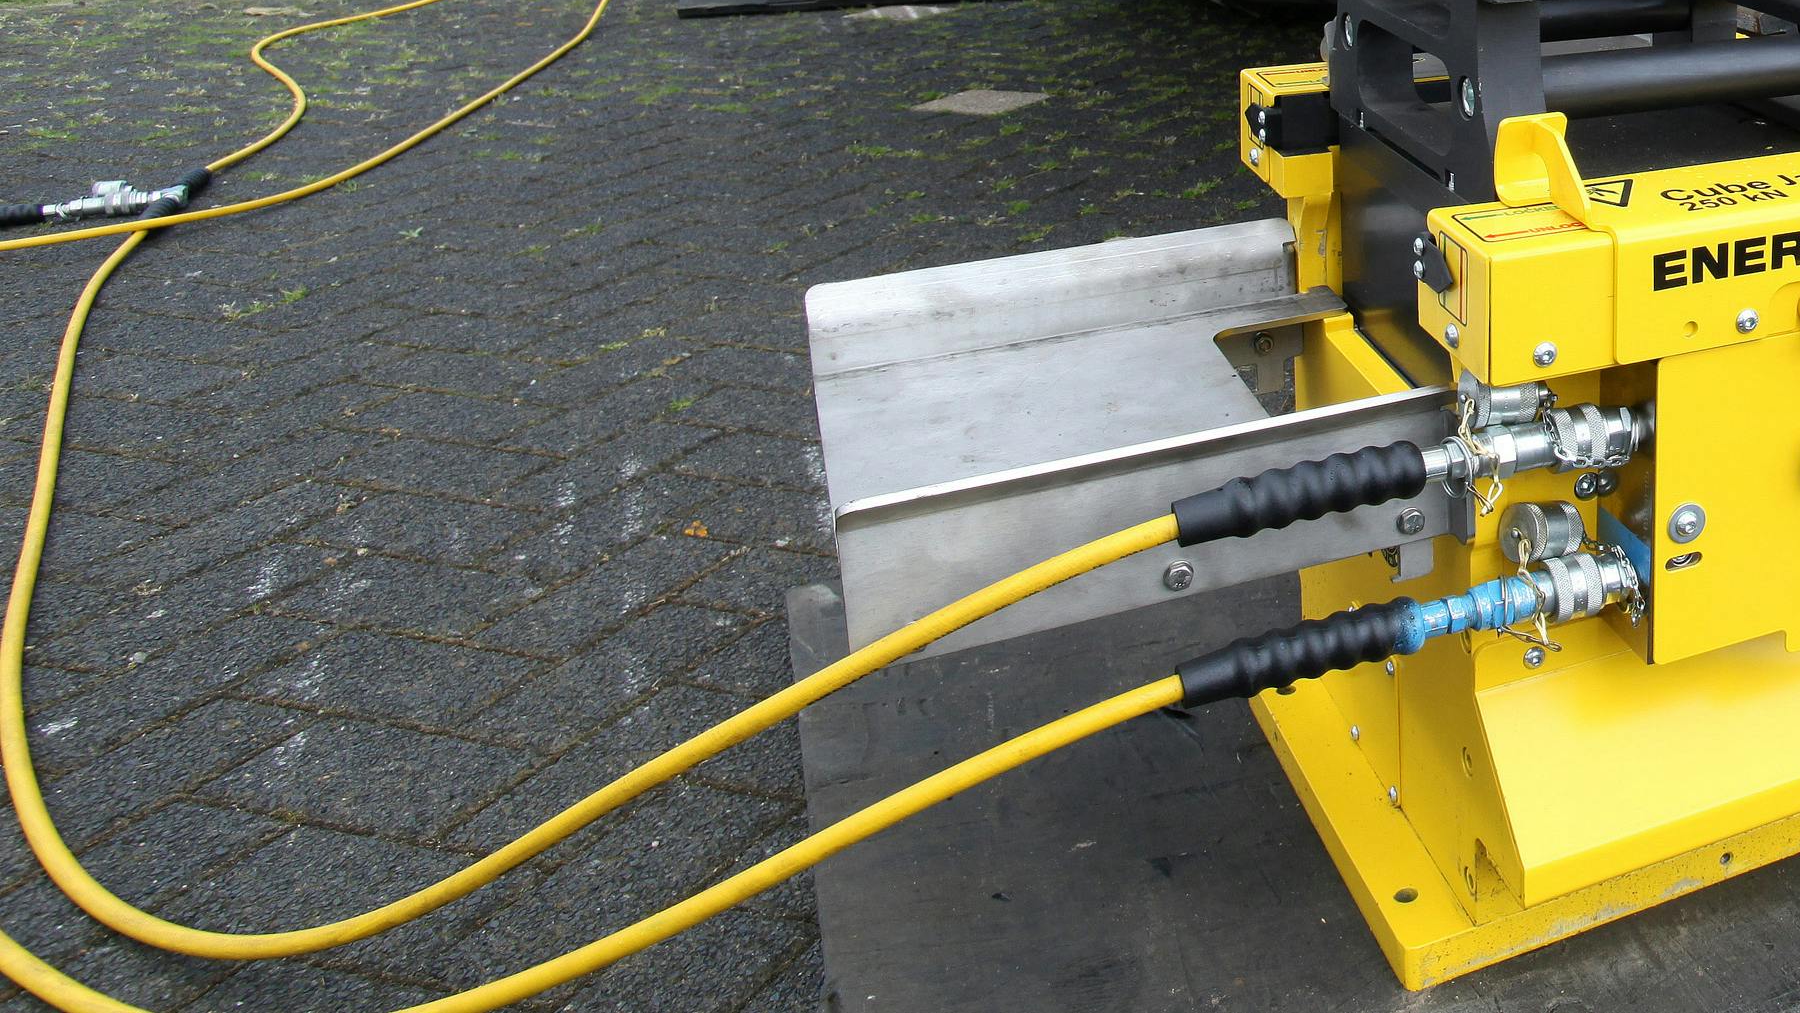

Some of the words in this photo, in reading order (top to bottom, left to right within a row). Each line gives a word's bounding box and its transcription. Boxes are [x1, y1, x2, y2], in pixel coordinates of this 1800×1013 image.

[1660, 179, 1771, 202] Cube
[1679, 196, 1738, 212] 250
[1742, 189, 1789, 202] kN
